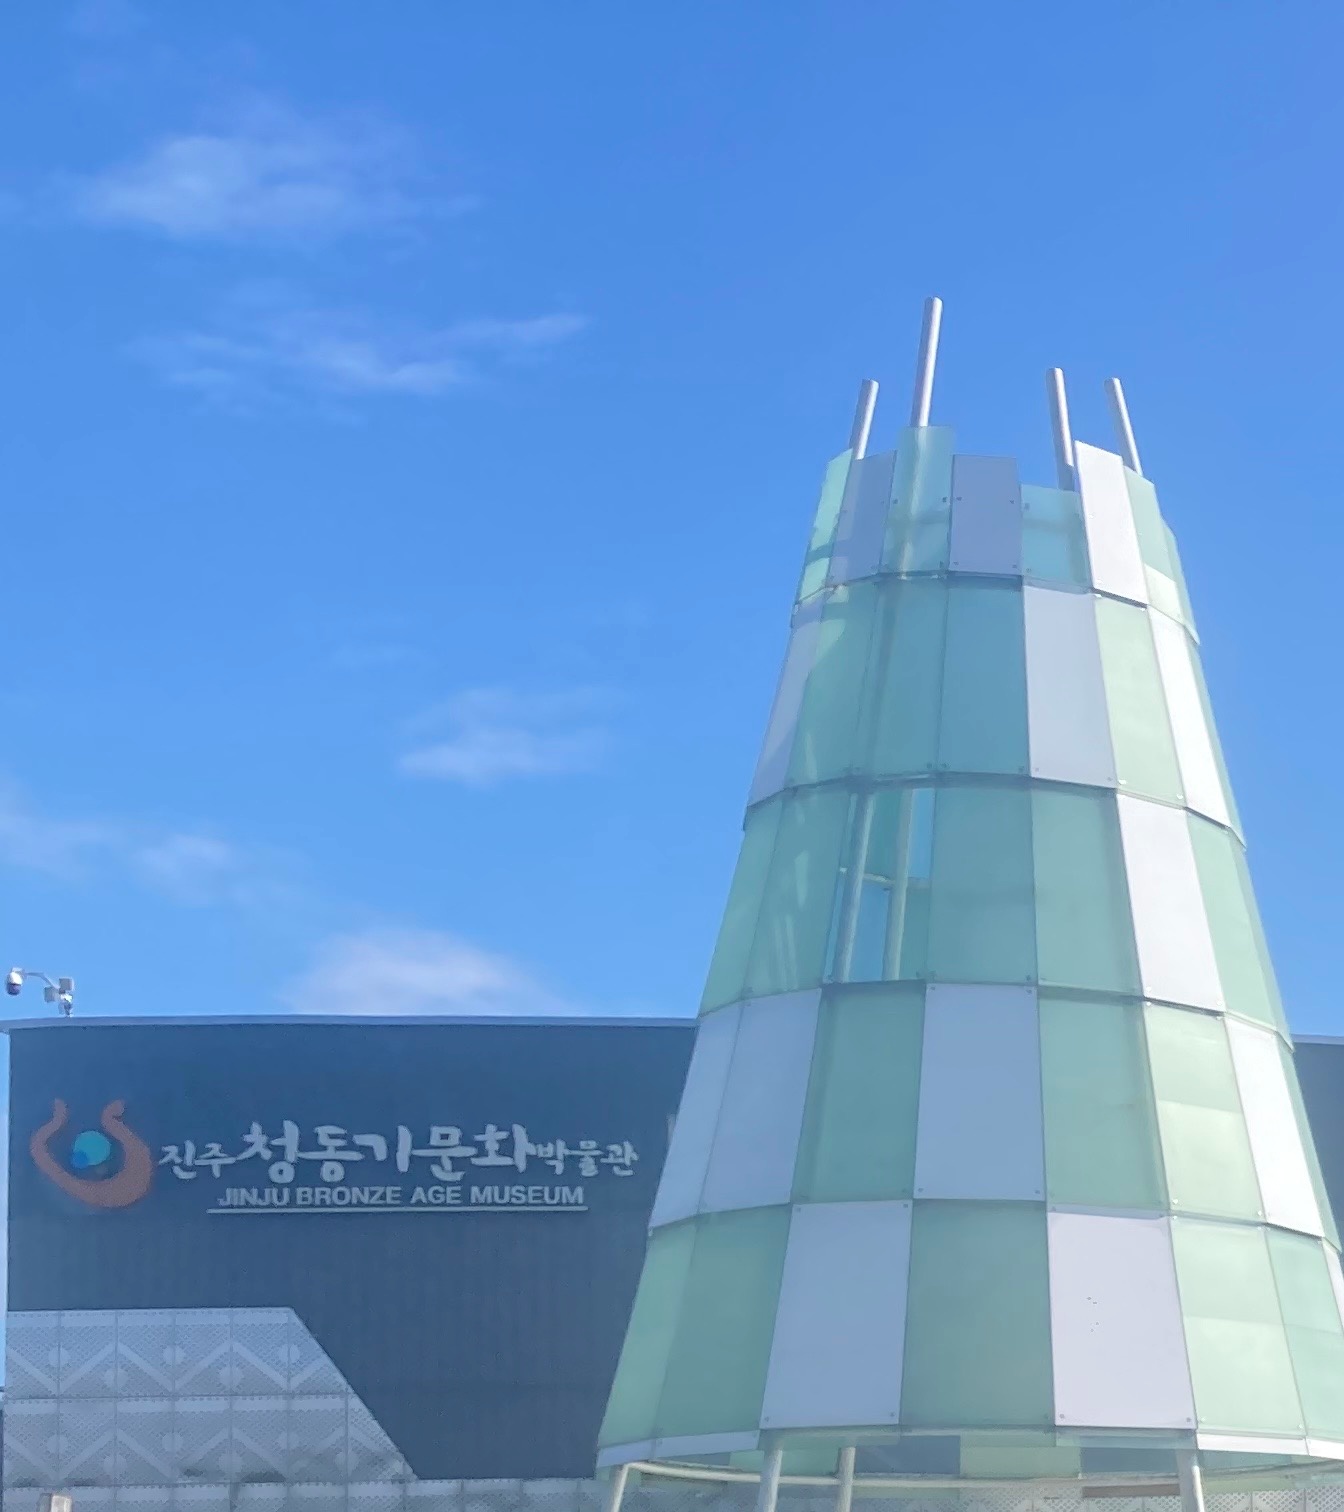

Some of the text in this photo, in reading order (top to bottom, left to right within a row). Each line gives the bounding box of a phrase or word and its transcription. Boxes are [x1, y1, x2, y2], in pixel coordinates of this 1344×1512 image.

[217, 1185, 584, 1206] JINJU BRONZE AGE MUSEUM
